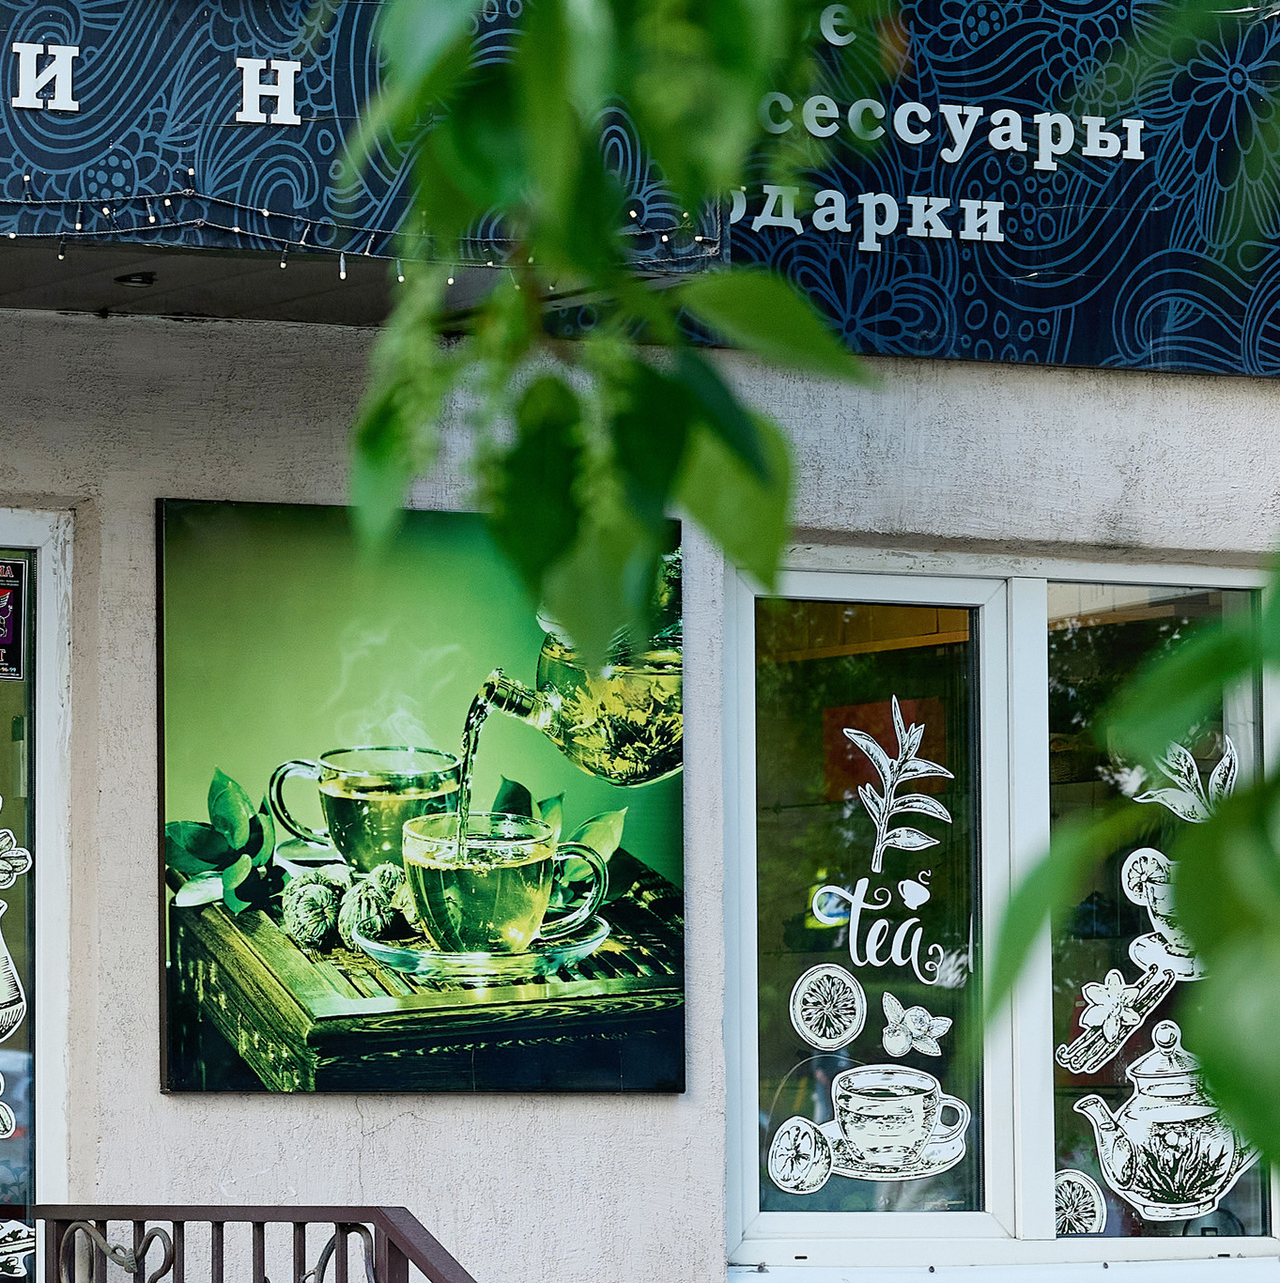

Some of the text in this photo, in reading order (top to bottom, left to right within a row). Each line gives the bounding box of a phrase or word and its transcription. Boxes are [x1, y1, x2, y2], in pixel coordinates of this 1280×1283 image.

[758, 92, 1145, 171] сессуары
[730, 185, 1006, 252] дарки
[812, 877, 945, 985] tea
